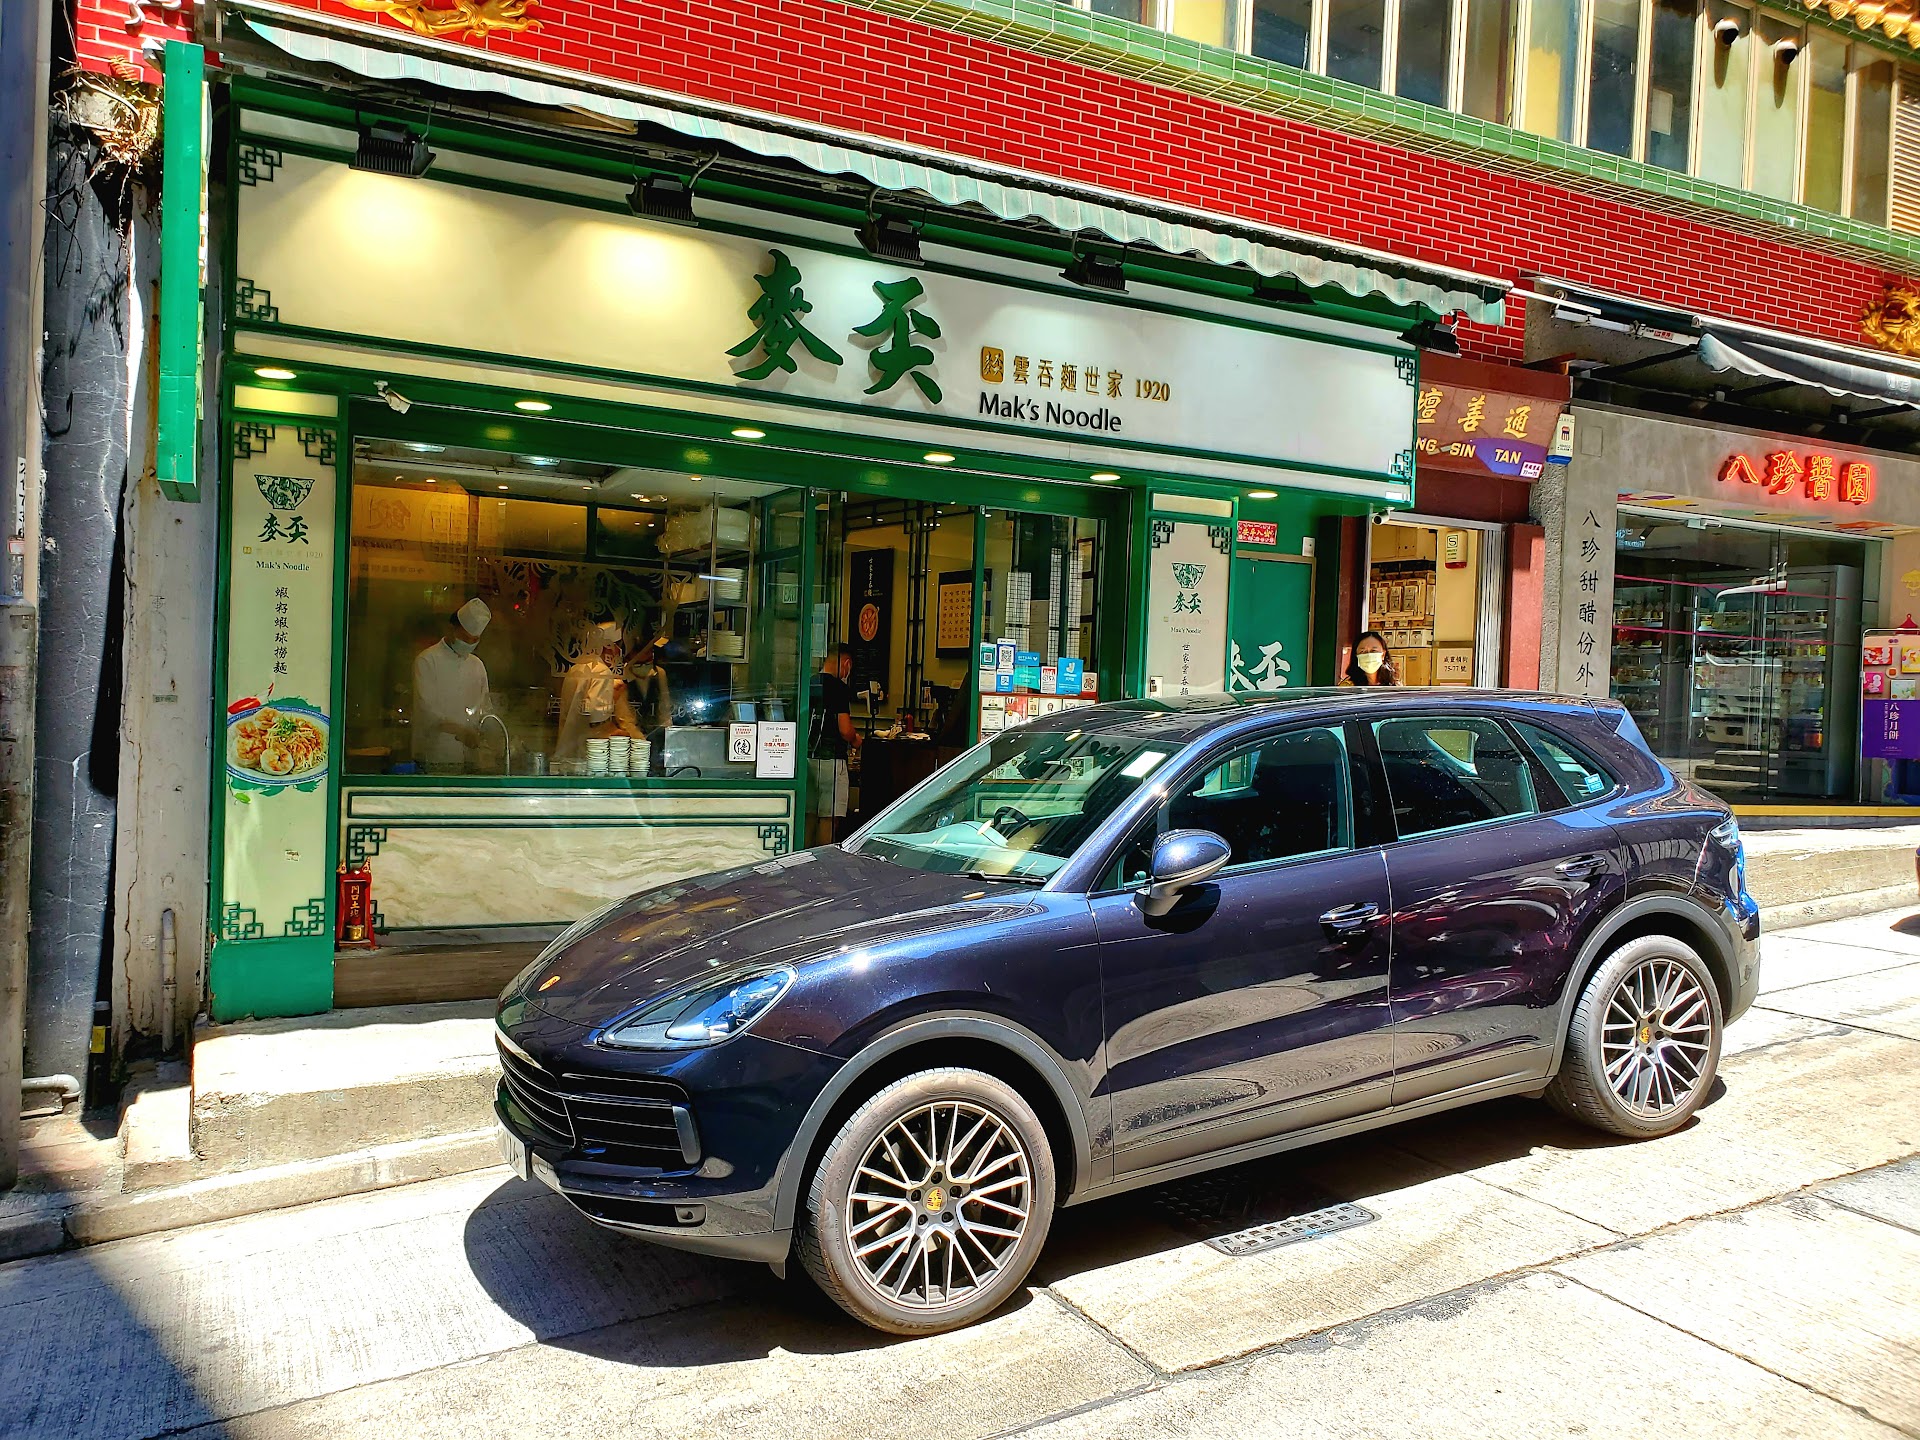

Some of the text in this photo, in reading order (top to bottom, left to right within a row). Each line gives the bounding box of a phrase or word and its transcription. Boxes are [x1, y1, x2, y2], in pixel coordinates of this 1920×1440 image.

[725, 248, 943, 405] 麥奀
[1014, 355, 1124, 399] 雲吞麵世家
[1136, 379, 1171, 402] 1920
[979, 391, 1122, 432] Mak's Noodle
[1450, 443, 1476, 458] SIN
[1495, 449, 1522, 464] TAN
[1726, 450, 1871, 503] 八珍醬園
[258, 512, 309, 545] 麥奀
[256, 560, 310, 571] Mak's Noodle
[1172, 590, 1202, 615] 麥奀
[1576, 509, 1602, 696] 八珍甜醋份外
